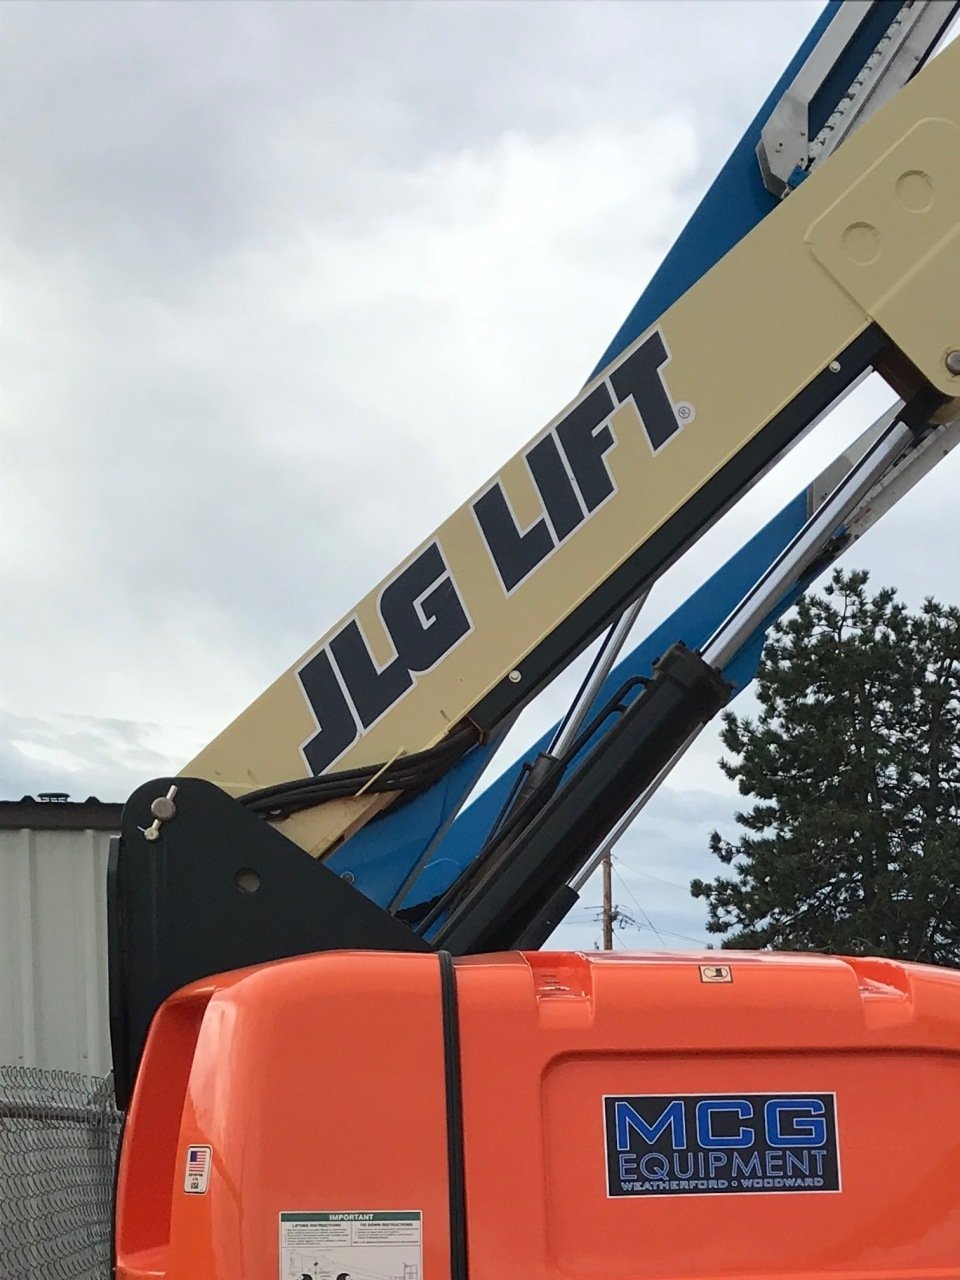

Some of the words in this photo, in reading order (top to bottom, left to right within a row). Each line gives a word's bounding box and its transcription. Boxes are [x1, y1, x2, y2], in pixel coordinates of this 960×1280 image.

[297, 539, 473, 777] JLG
[471, 328, 682, 595] LIFT
[615, 1099, 827, 1150] MCG
[619, 1150, 827, 1180] EQUIPMENT
[621, 1179, 728, 1191] WEATHERFORD
[741, 1177, 824, 1188] WOODWARD
